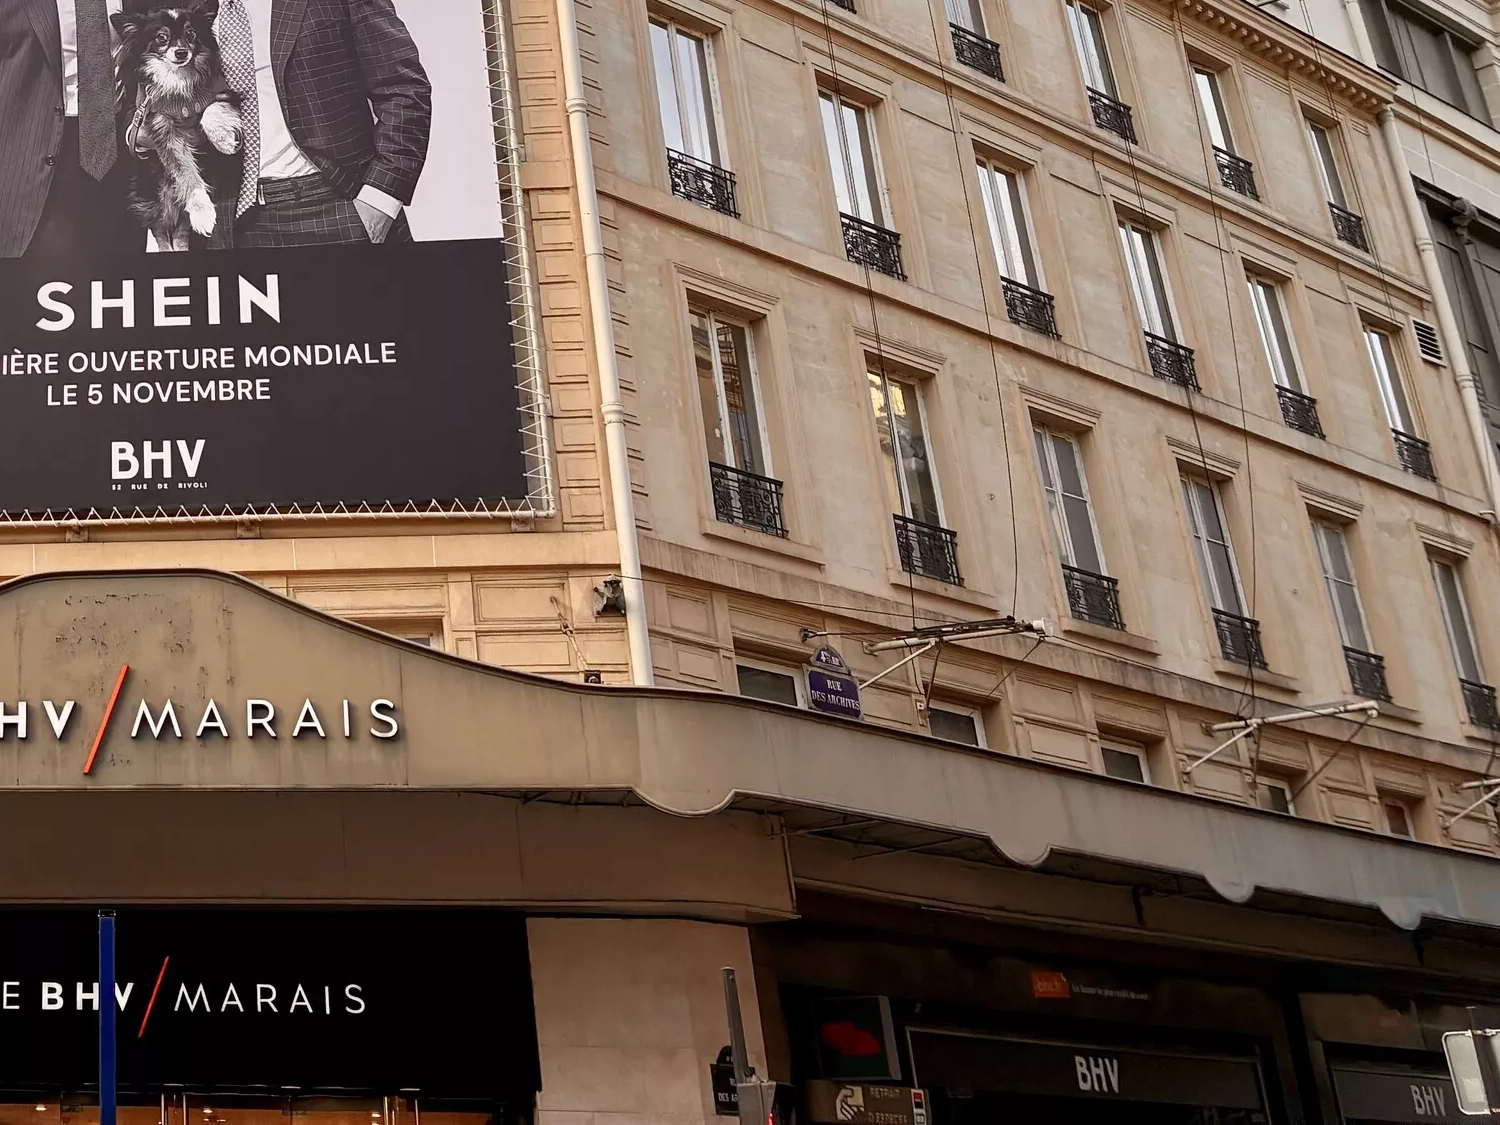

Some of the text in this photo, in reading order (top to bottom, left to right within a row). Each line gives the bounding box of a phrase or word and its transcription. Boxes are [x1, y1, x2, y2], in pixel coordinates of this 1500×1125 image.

[35, 274, 281, 332] SHEIN
[68, 346, 235, 373] OUVERTURE
[244, 342, 397, 368] MONDIALE
[47, 378, 271, 406] LE 5 NOVEMBRE
[111, 439, 206, 480] BHV
[811, 690, 860, 711] DES ARCHIVES
[826, 679, 843, 692] RUE
[130, 697, 399, 740] MARAIS
[41, 981, 135, 1012] BHV
[174, 982, 367, 1015] MARAIS
[1073, 1055, 1120, 1093] BHV
[1409, 1085, 1447, 1117] BHV
